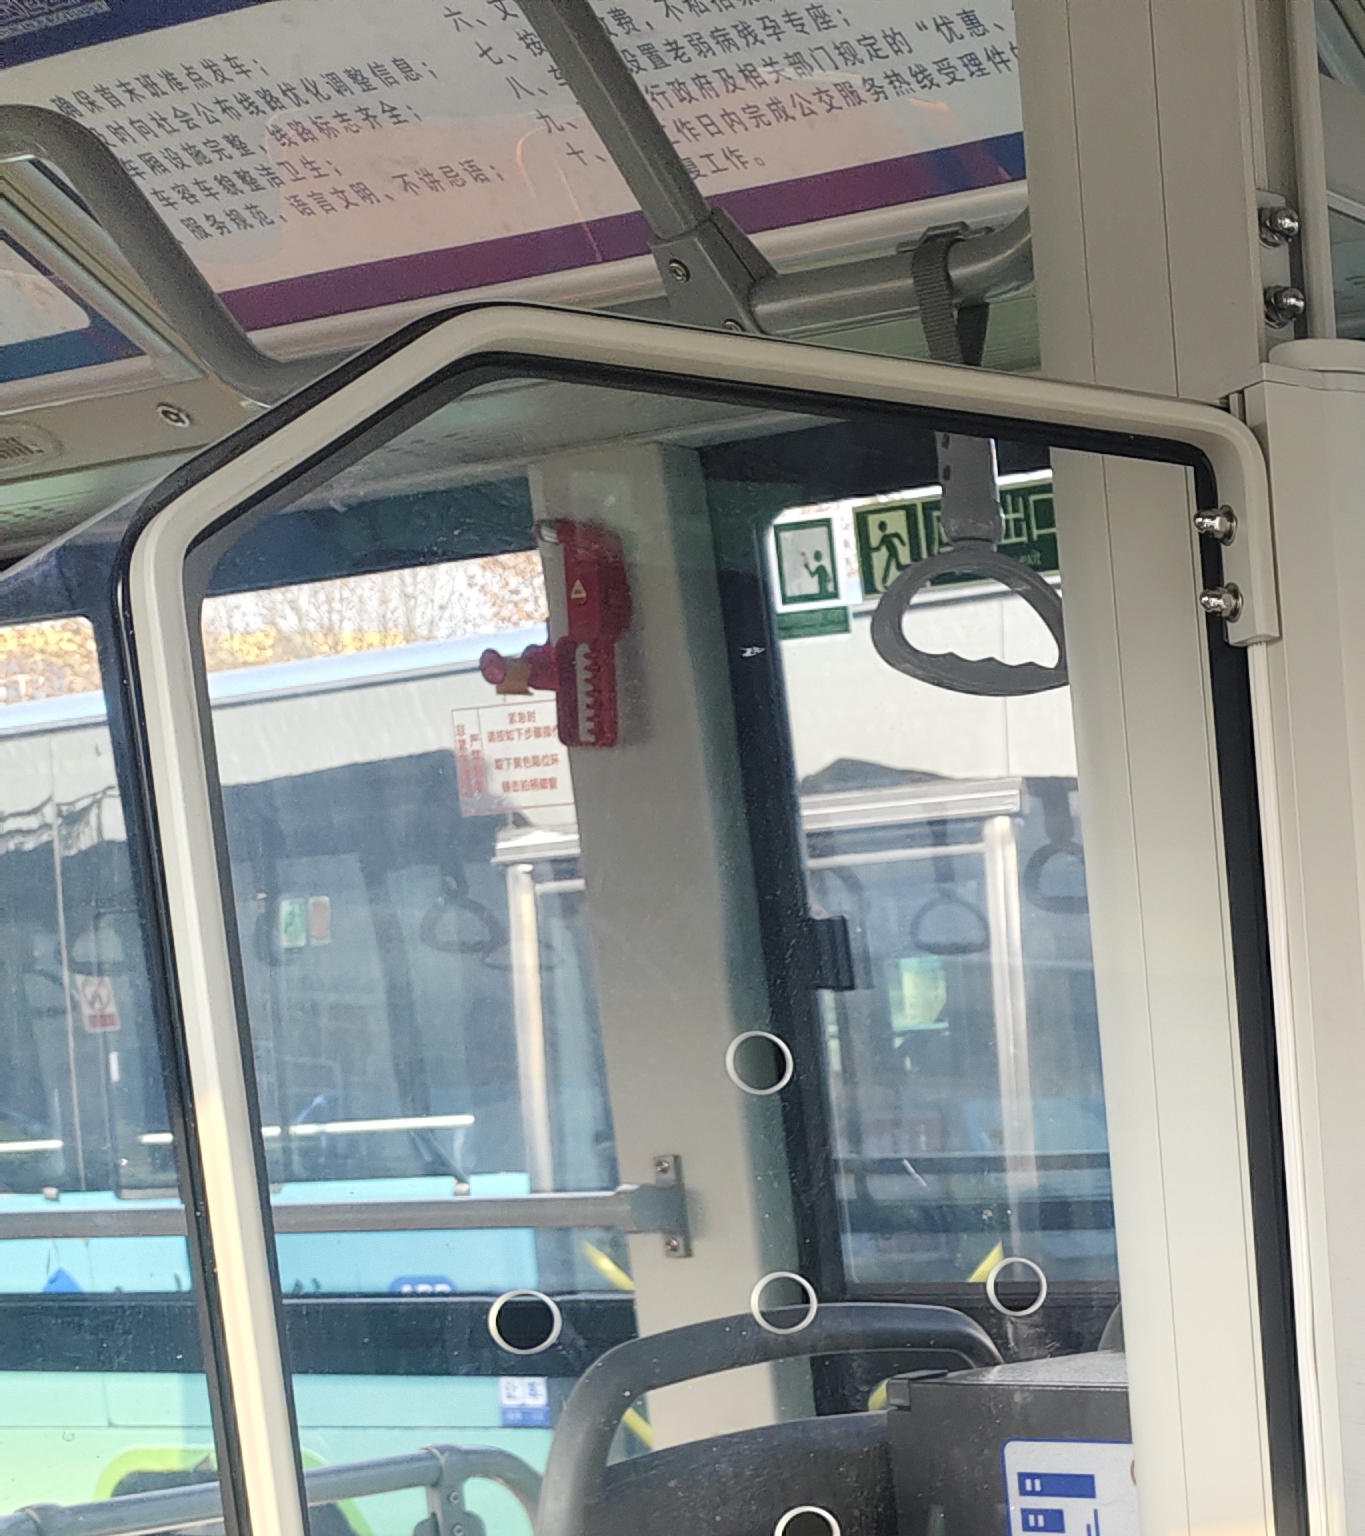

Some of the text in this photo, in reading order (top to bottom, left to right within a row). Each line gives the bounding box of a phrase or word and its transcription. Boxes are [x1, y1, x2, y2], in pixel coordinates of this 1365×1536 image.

[662, 40, 1018, 145] 作日内完成公交服务热线受理件
